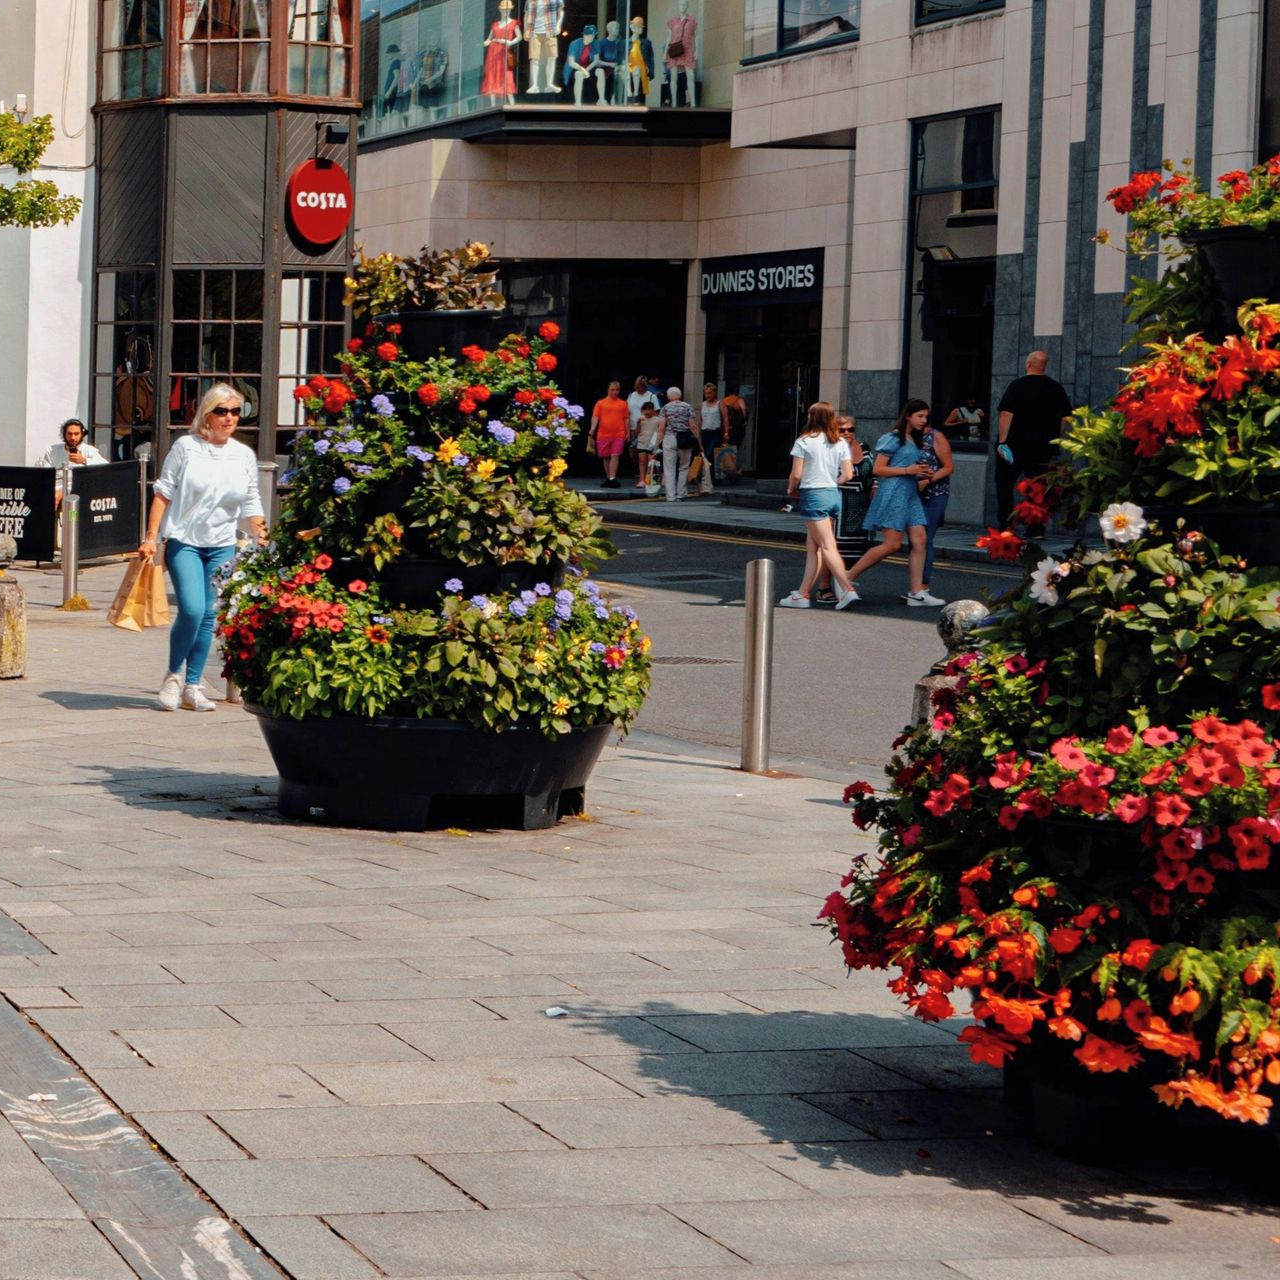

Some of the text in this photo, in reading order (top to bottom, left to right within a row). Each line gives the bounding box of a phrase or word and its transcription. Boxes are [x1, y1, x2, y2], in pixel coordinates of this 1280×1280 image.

[297, 191, 347, 210] COSTA
[702, 264, 815, 295] DUNNES STORES
[14, 488, 26, 500] OF
[90, 497, 117, 512] COSTA
